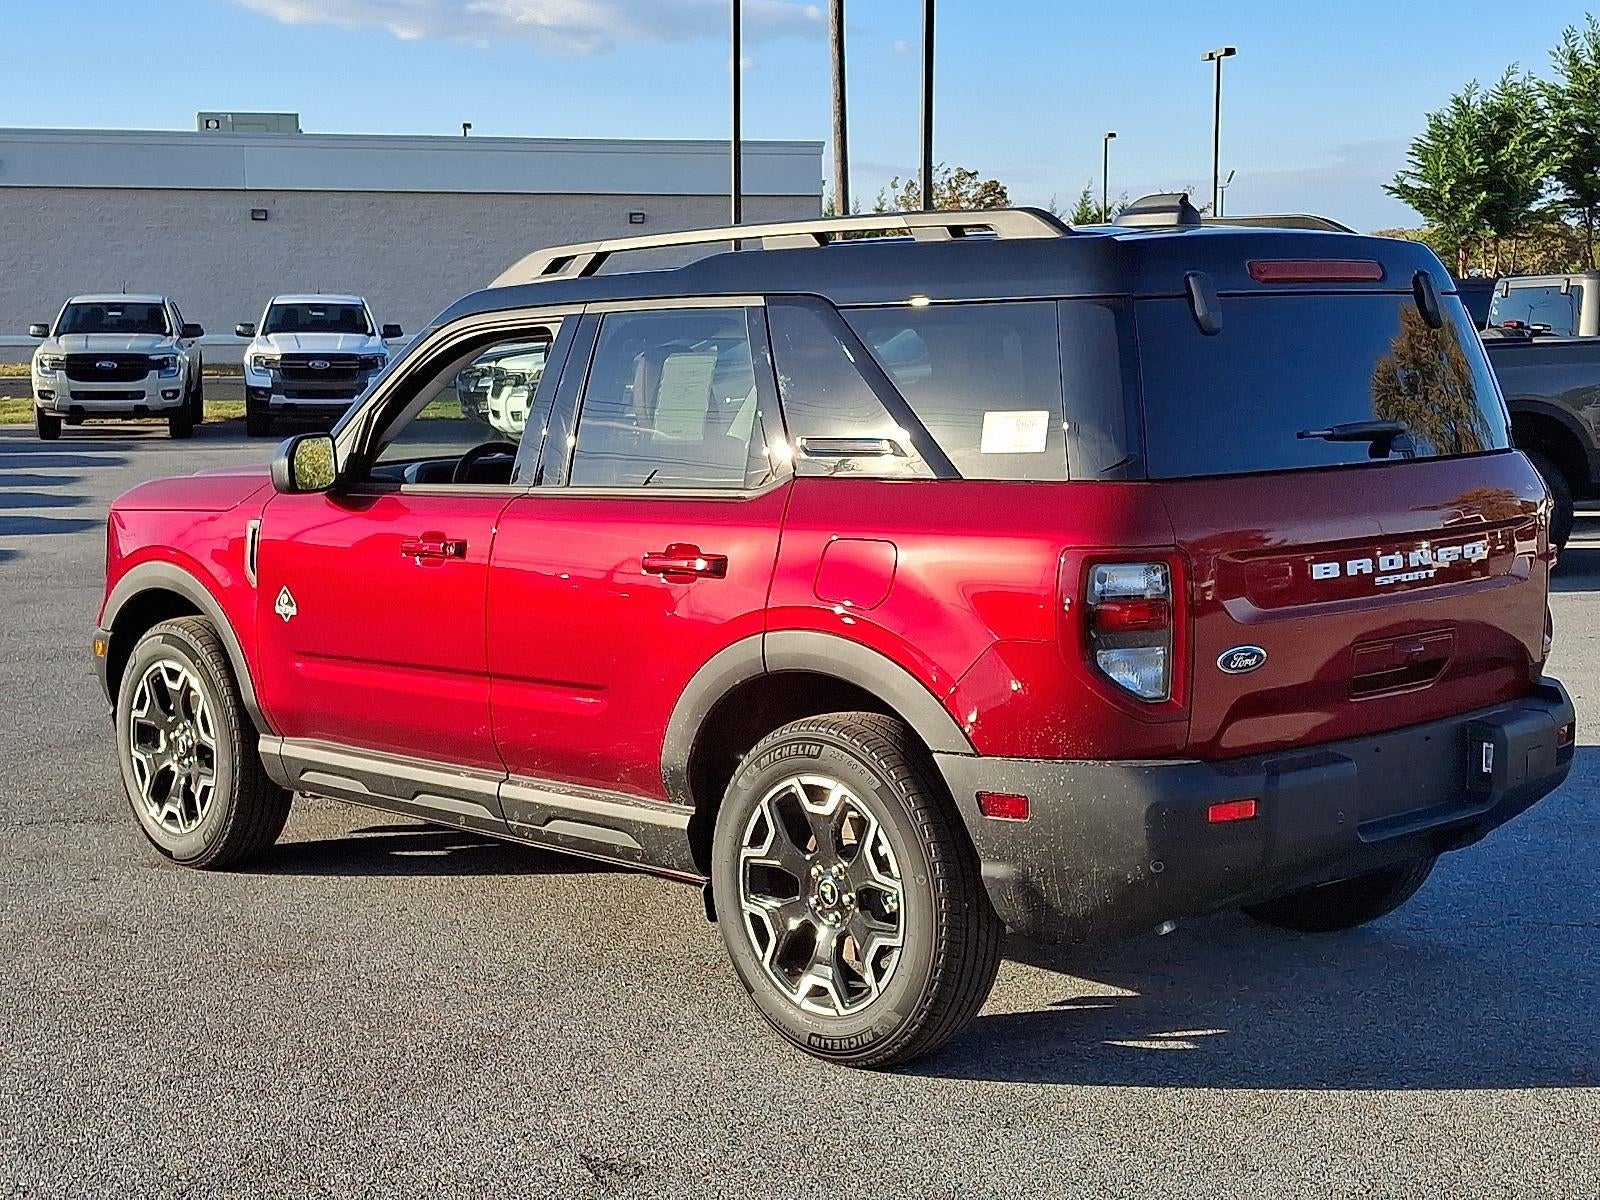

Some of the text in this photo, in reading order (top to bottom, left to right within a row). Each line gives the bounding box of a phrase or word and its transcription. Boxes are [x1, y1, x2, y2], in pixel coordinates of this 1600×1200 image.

[1312, 541, 1487, 580] BRONCO
[1375, 569, 1437, 586] SPORT
[1230, 652, 1257, 668] Ford
[760, 743, 821, 770] MICHELIN
[809, 1029, 874, 1050] MICHELIN
